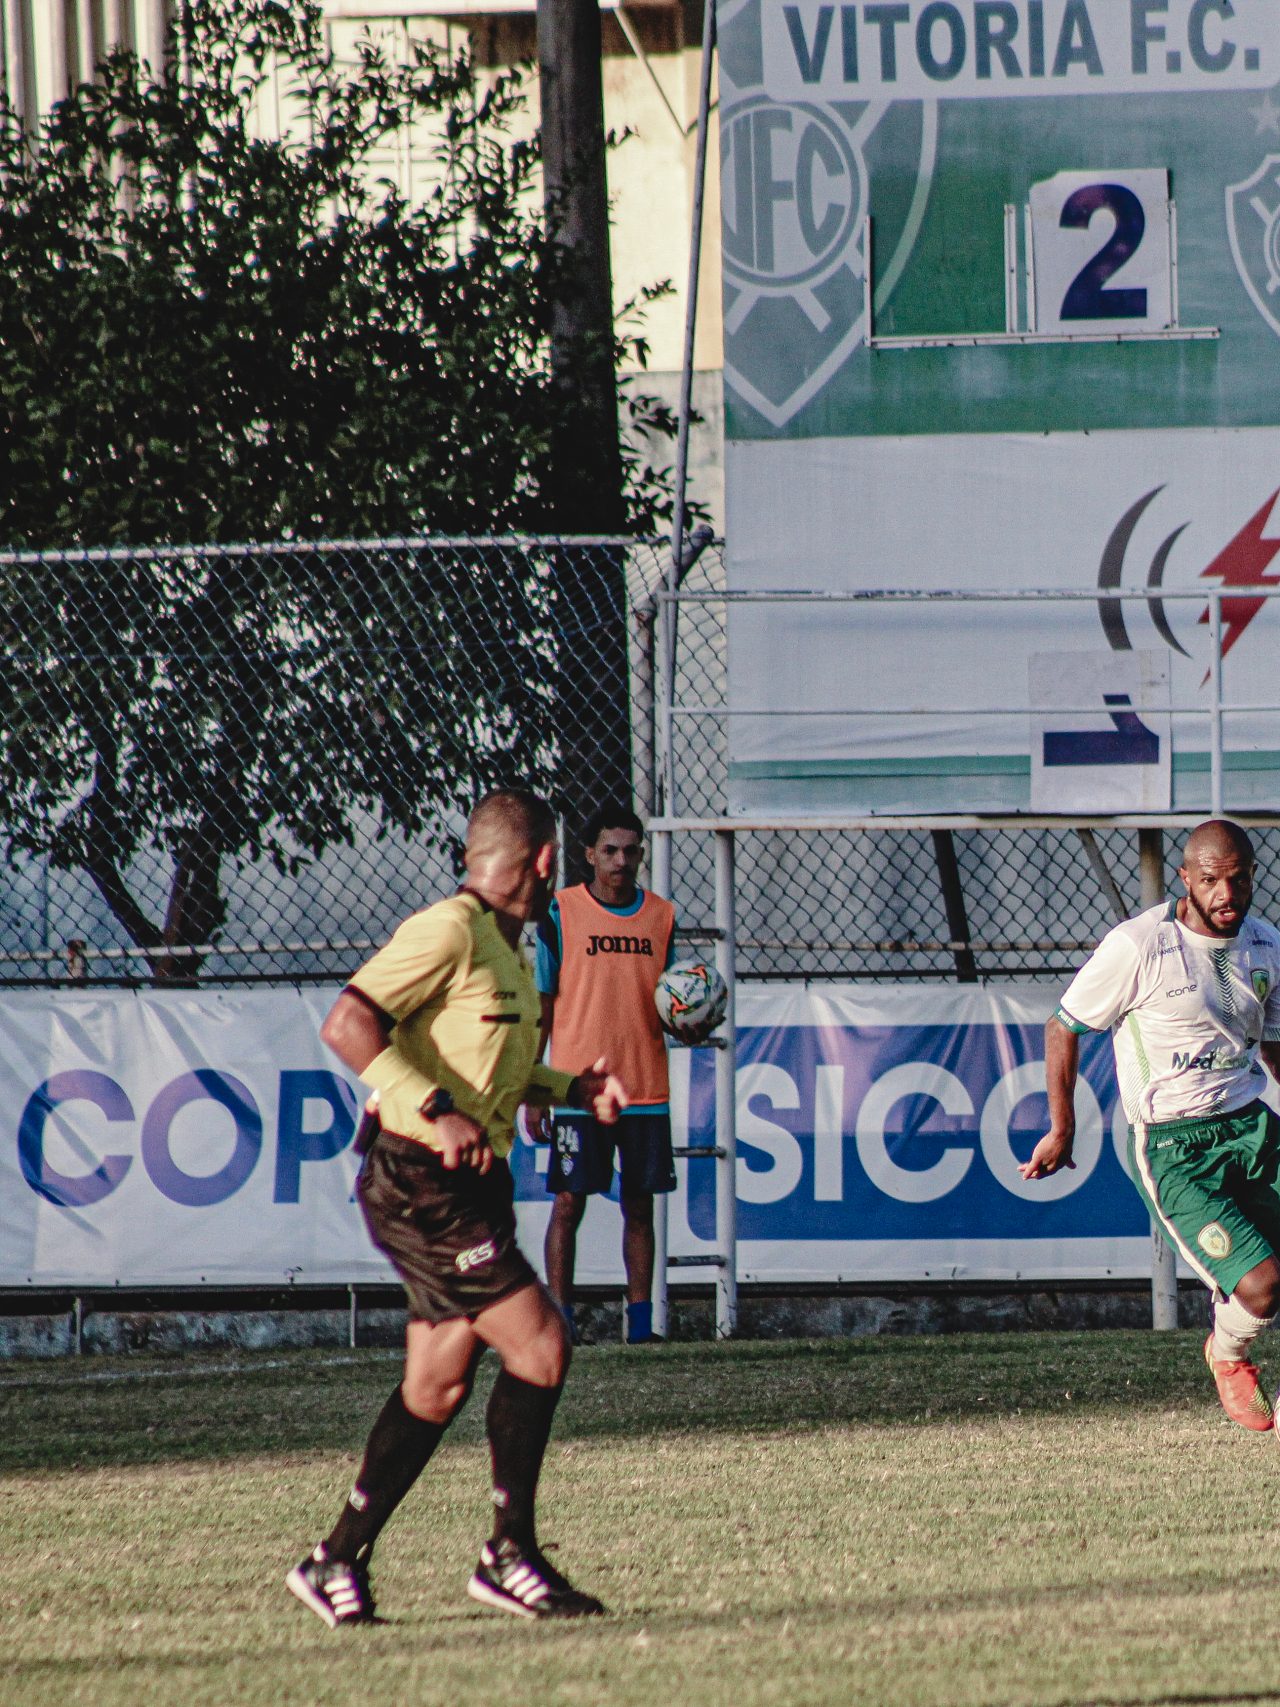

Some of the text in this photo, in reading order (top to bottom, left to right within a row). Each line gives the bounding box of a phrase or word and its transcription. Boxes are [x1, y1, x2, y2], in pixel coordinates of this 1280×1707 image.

[783, 0, 1261, 84] VITORIA F.C.
[1059, 183, 1147, 321] 2
[18, 1068, 361, 1208] COP
